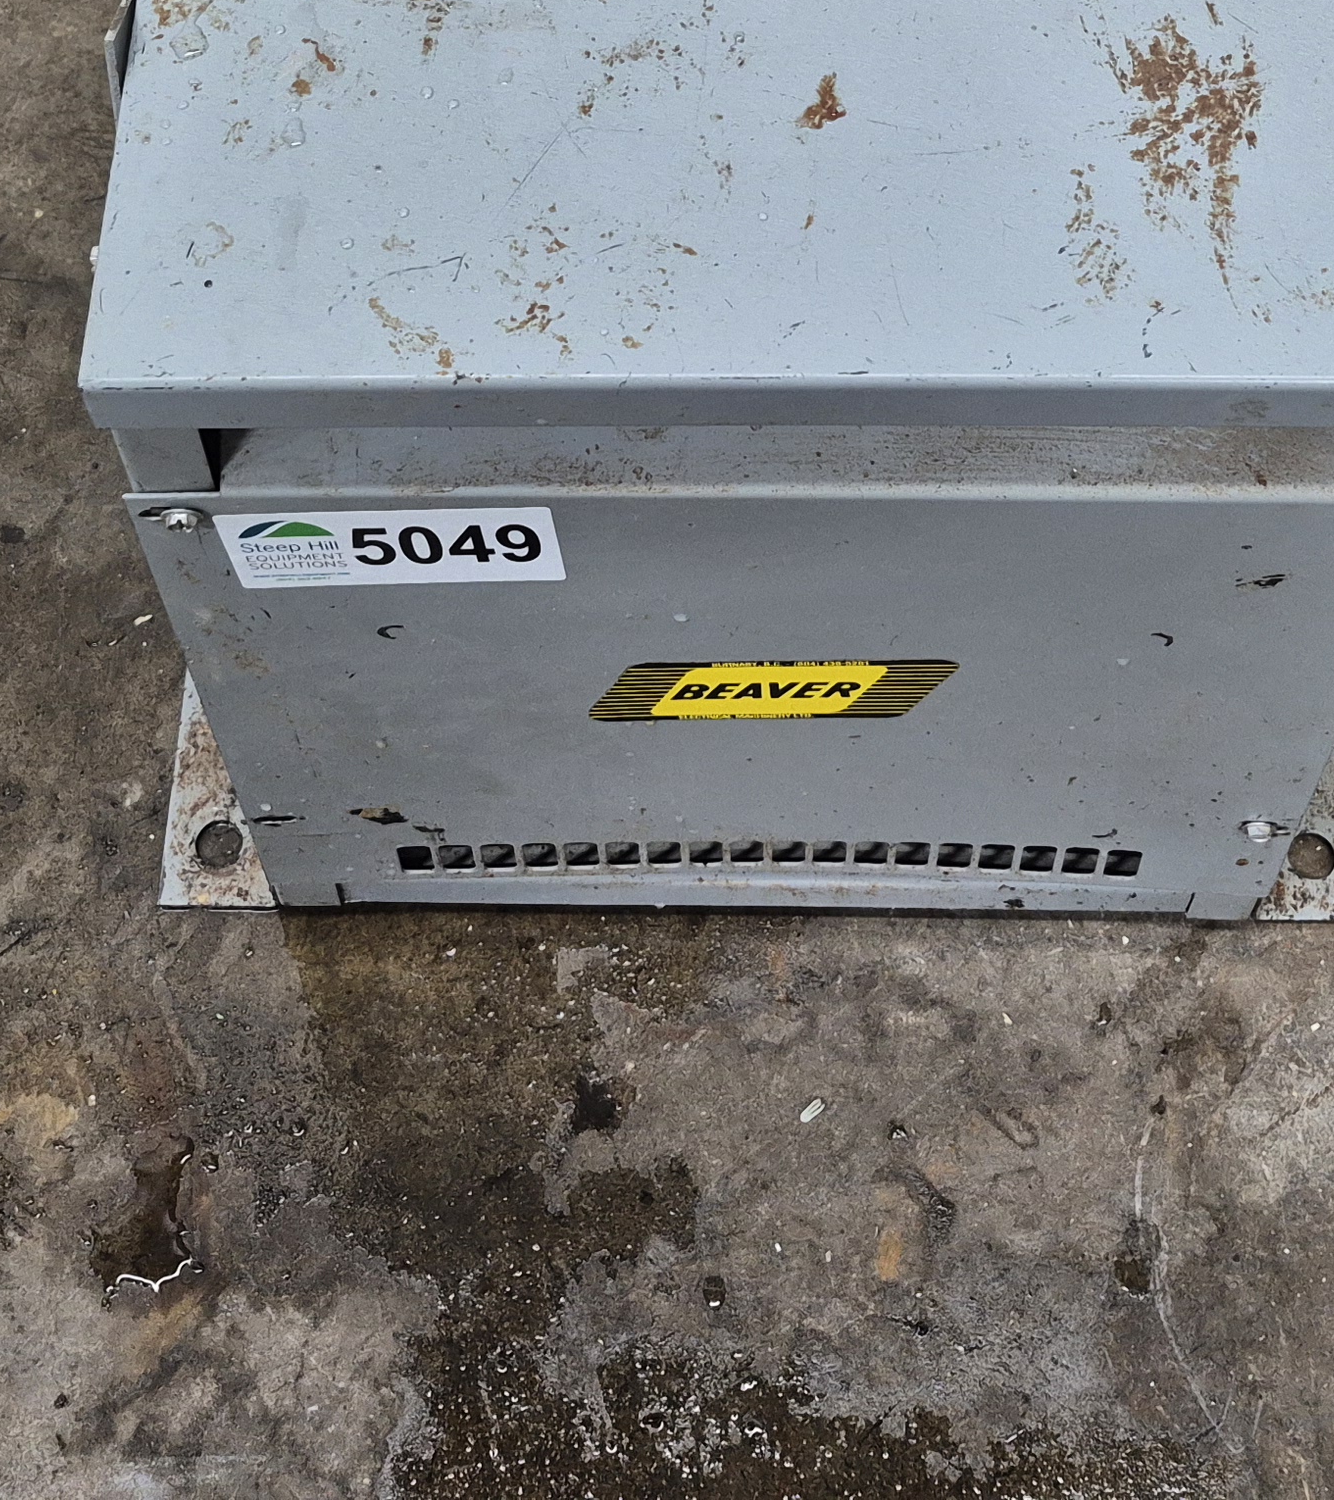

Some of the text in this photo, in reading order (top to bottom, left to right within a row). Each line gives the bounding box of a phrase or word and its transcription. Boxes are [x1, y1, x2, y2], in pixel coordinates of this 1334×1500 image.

[240, 540, 340, 553] Steep Hill
[352, 524, 542, 565] 5049
[245, 553, 344, 562] EQUIPMENT
[249, 560, 348, 570] SOLUTIONS
[670, 681, 862, 700] BEAVER
